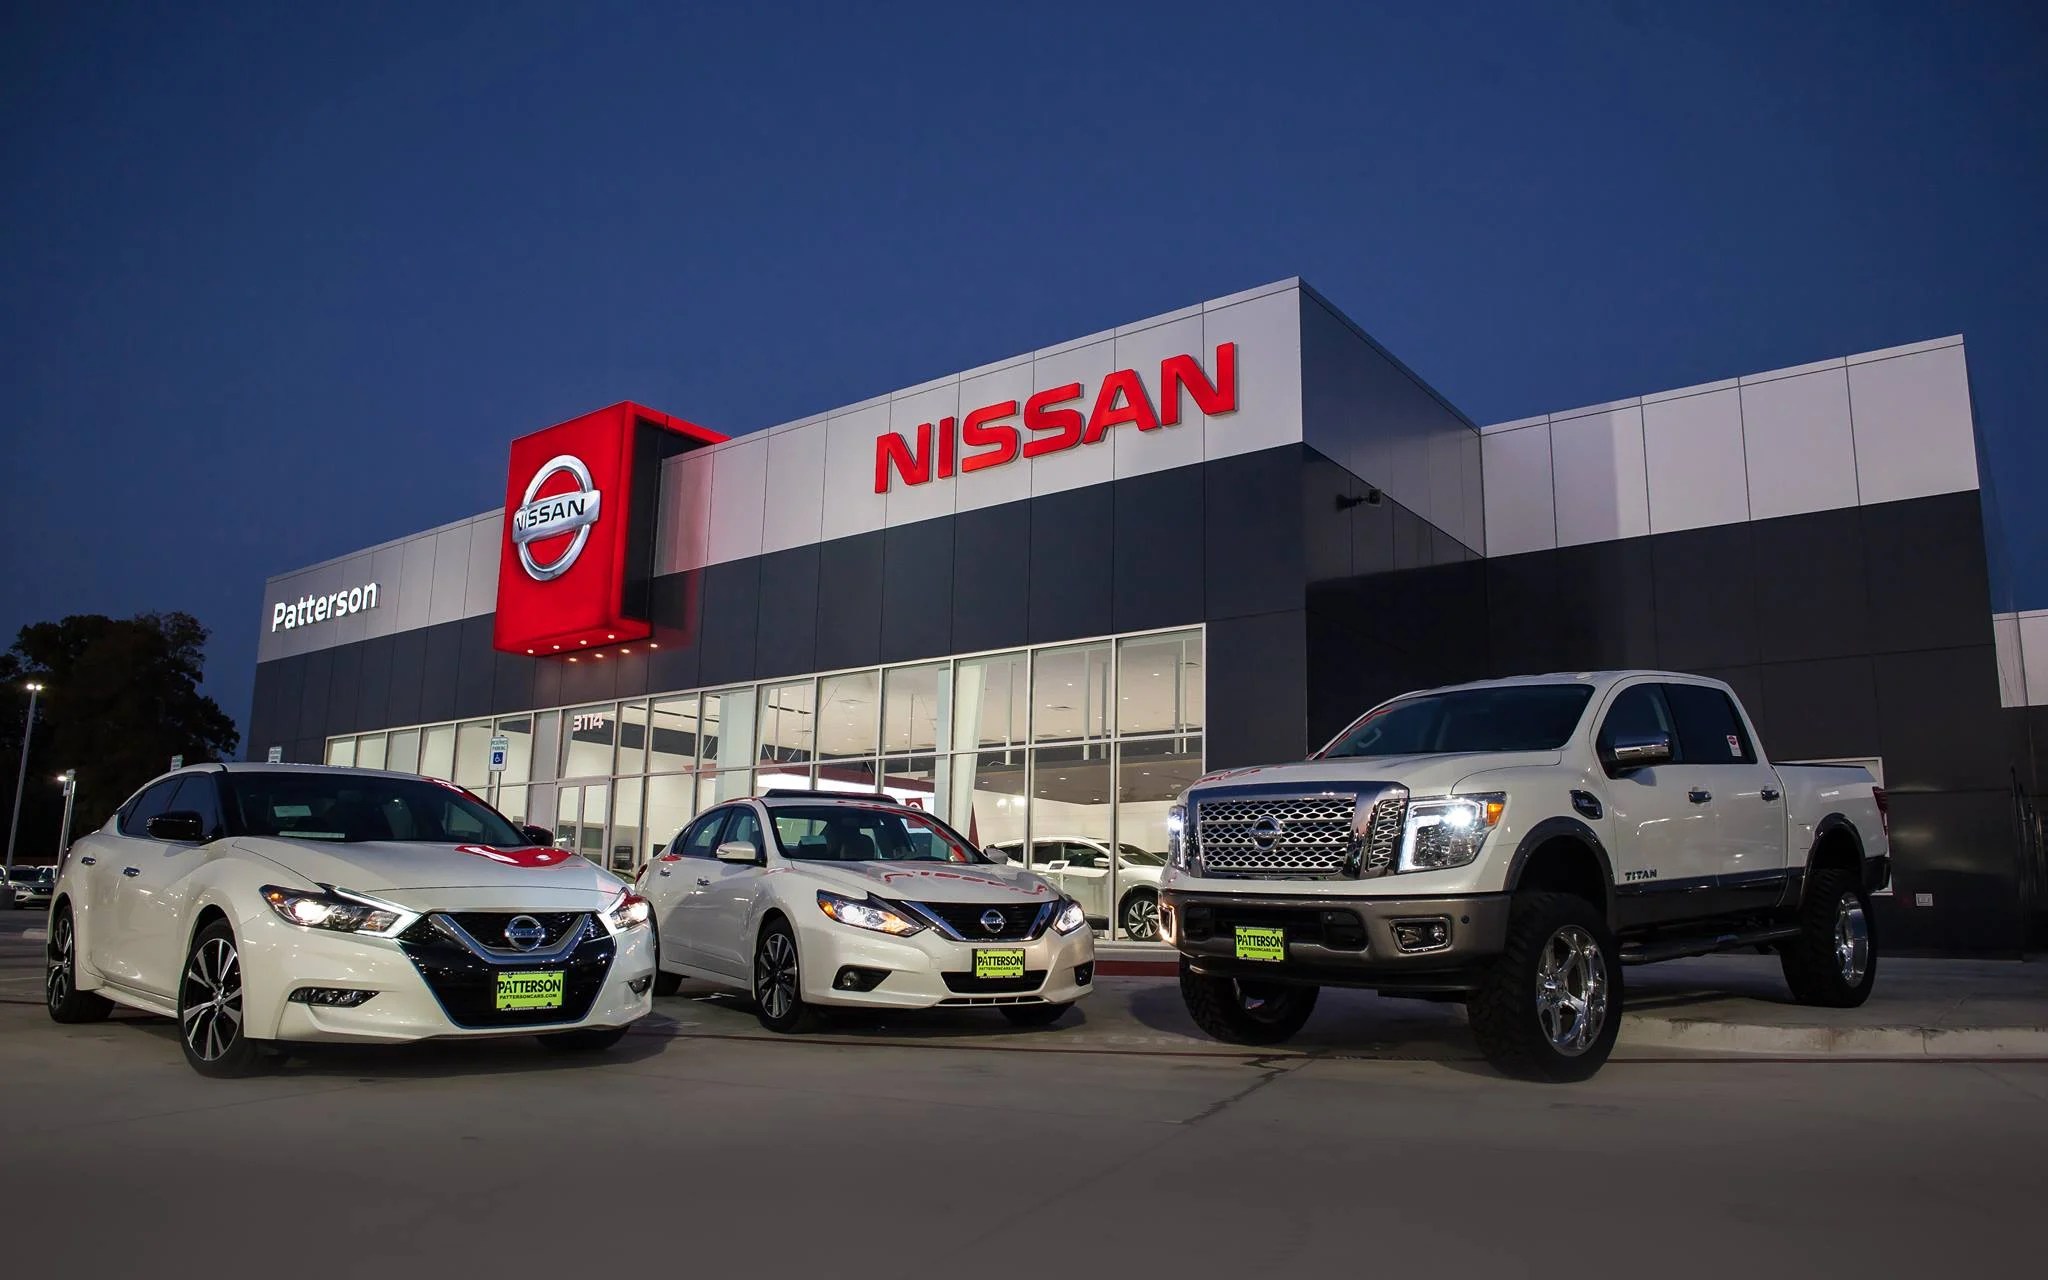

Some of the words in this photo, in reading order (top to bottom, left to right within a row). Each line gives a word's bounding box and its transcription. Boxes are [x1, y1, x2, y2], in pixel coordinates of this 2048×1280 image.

[874, 342, 1236, 494] NISSAN
[516, 498, 585, 532] NISSAN
[271, 582, 377, 632] Patterson
[572, 712, 604, 732] 3114
[1625, 869, 1657, 881] TITAN
[1237, 934, 1283, 948] PATTERSON
[977, 955, 1023, 966] PATTERSON
[498, 979, 561, 993] PATTERSON
